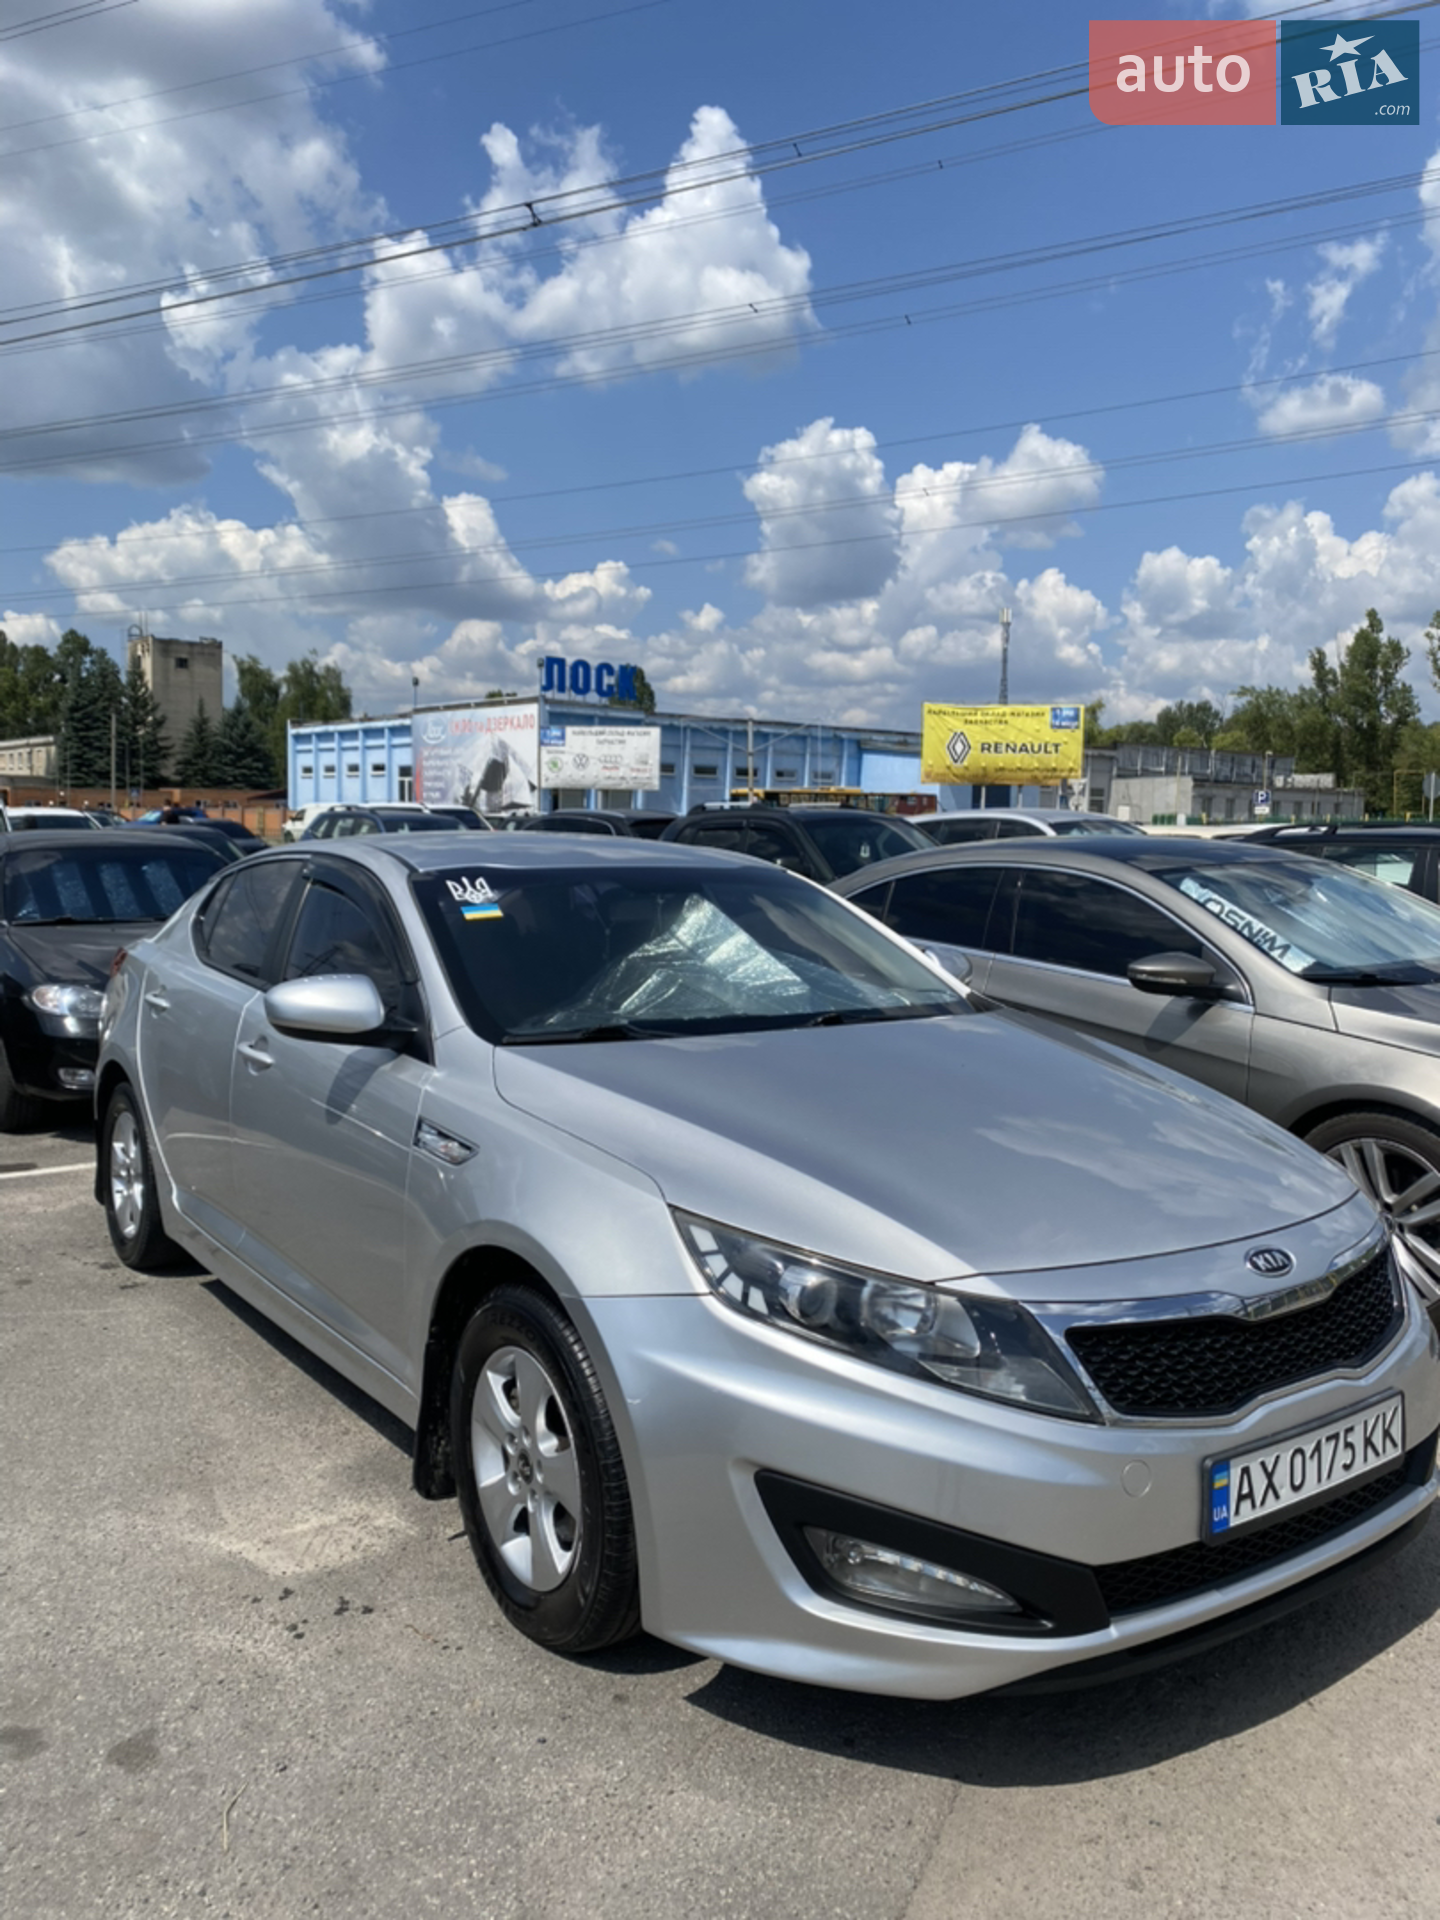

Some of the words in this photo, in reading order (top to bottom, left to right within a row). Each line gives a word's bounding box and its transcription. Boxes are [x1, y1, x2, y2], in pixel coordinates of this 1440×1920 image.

[541, 656, 637, 700] ЛОСК
[485, 713, 535, 735] ДЗЕРКАЛО
[981, 742, 1062, 755] RENAULT
[1258, 790, 1267, 804] P
[1252, 1250, 1289, 1271] KIA
[1233, 1453, 1280, 1516] AX
[1289, 1425, 1356, 1493] 0175
[1363, 1405, 1398, 1464] KK
[1213, 1504, 1228, 1523] UA
